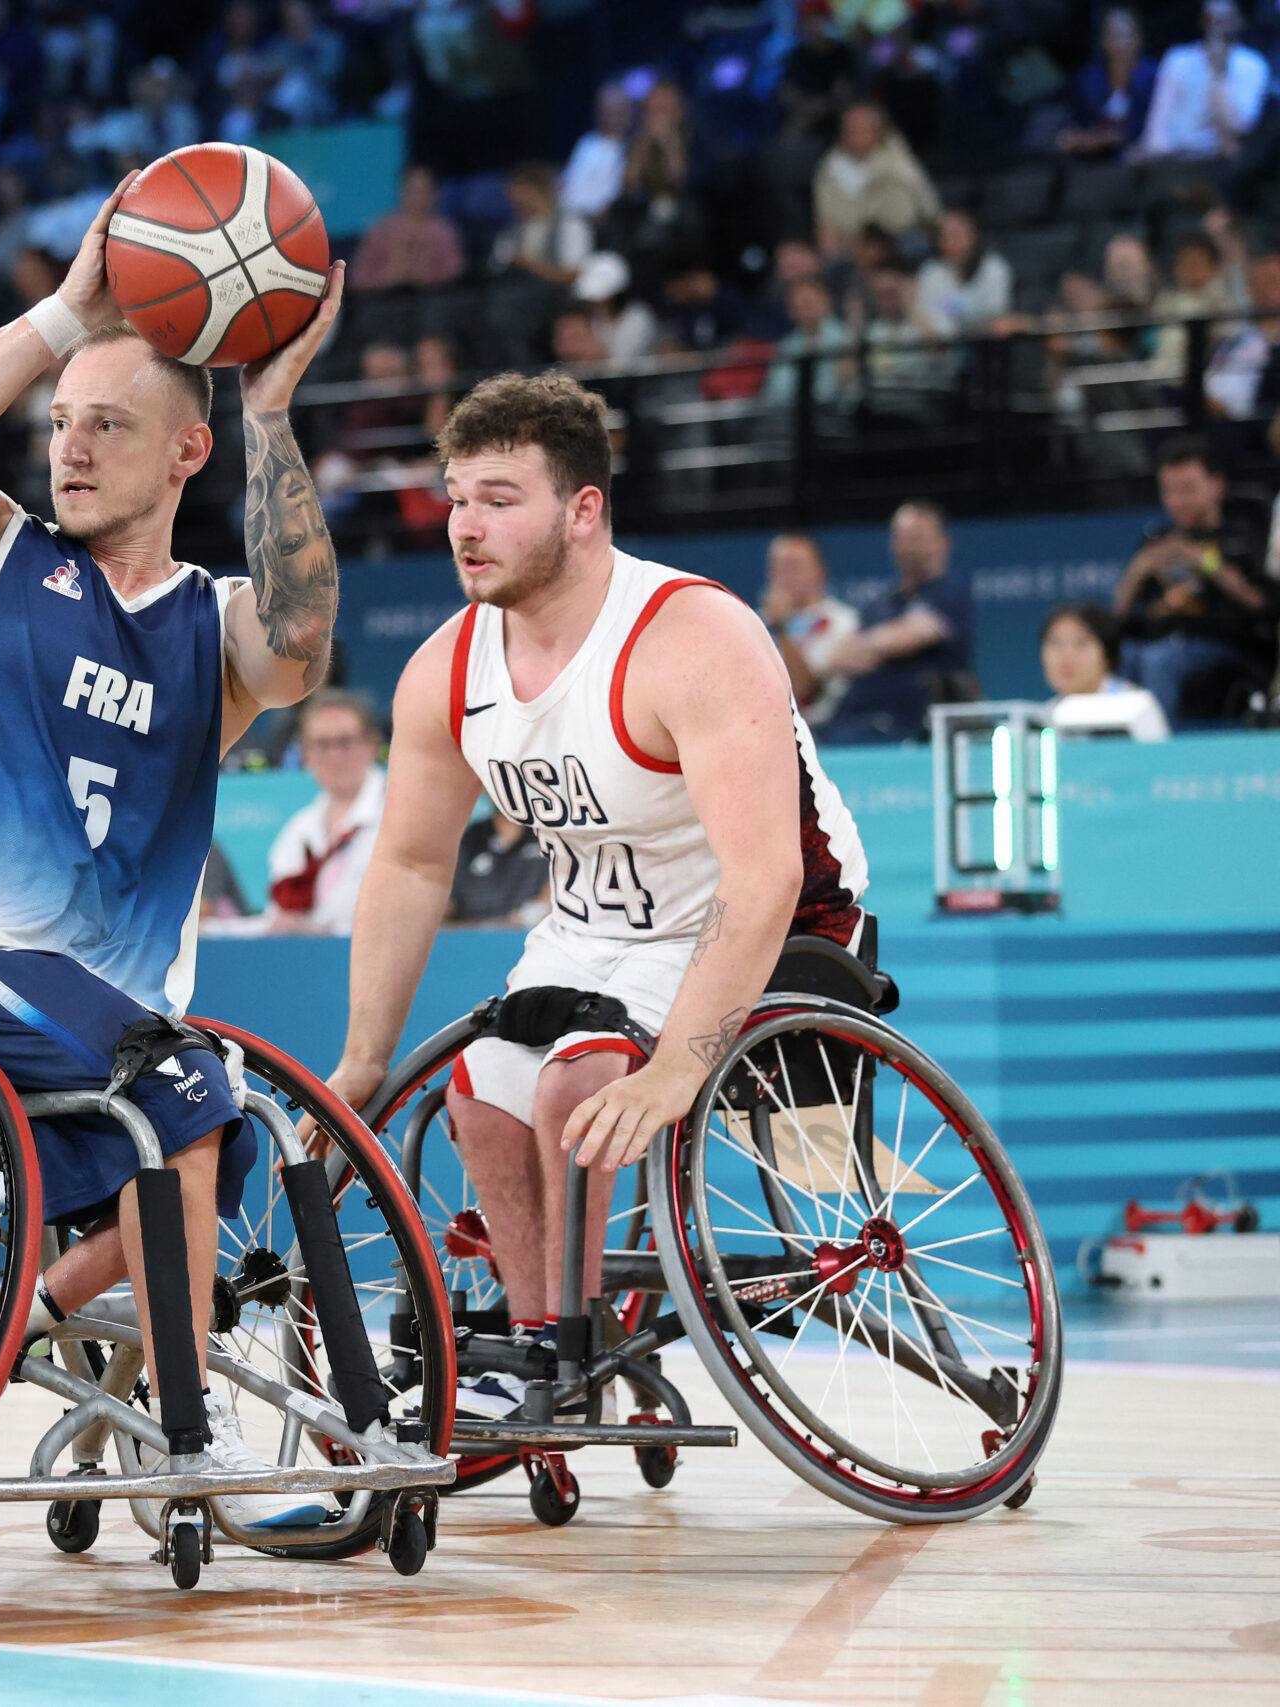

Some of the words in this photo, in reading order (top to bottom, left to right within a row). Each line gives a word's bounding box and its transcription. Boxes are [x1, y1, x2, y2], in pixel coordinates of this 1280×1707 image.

[62, 655, 154, 735] FRA
[67, 755, 118, 850] 5
[488, 755, 608, 827] USA
[535, 828, 655, 929] 24
[173, 1069, 204, 1094] FRANCE
